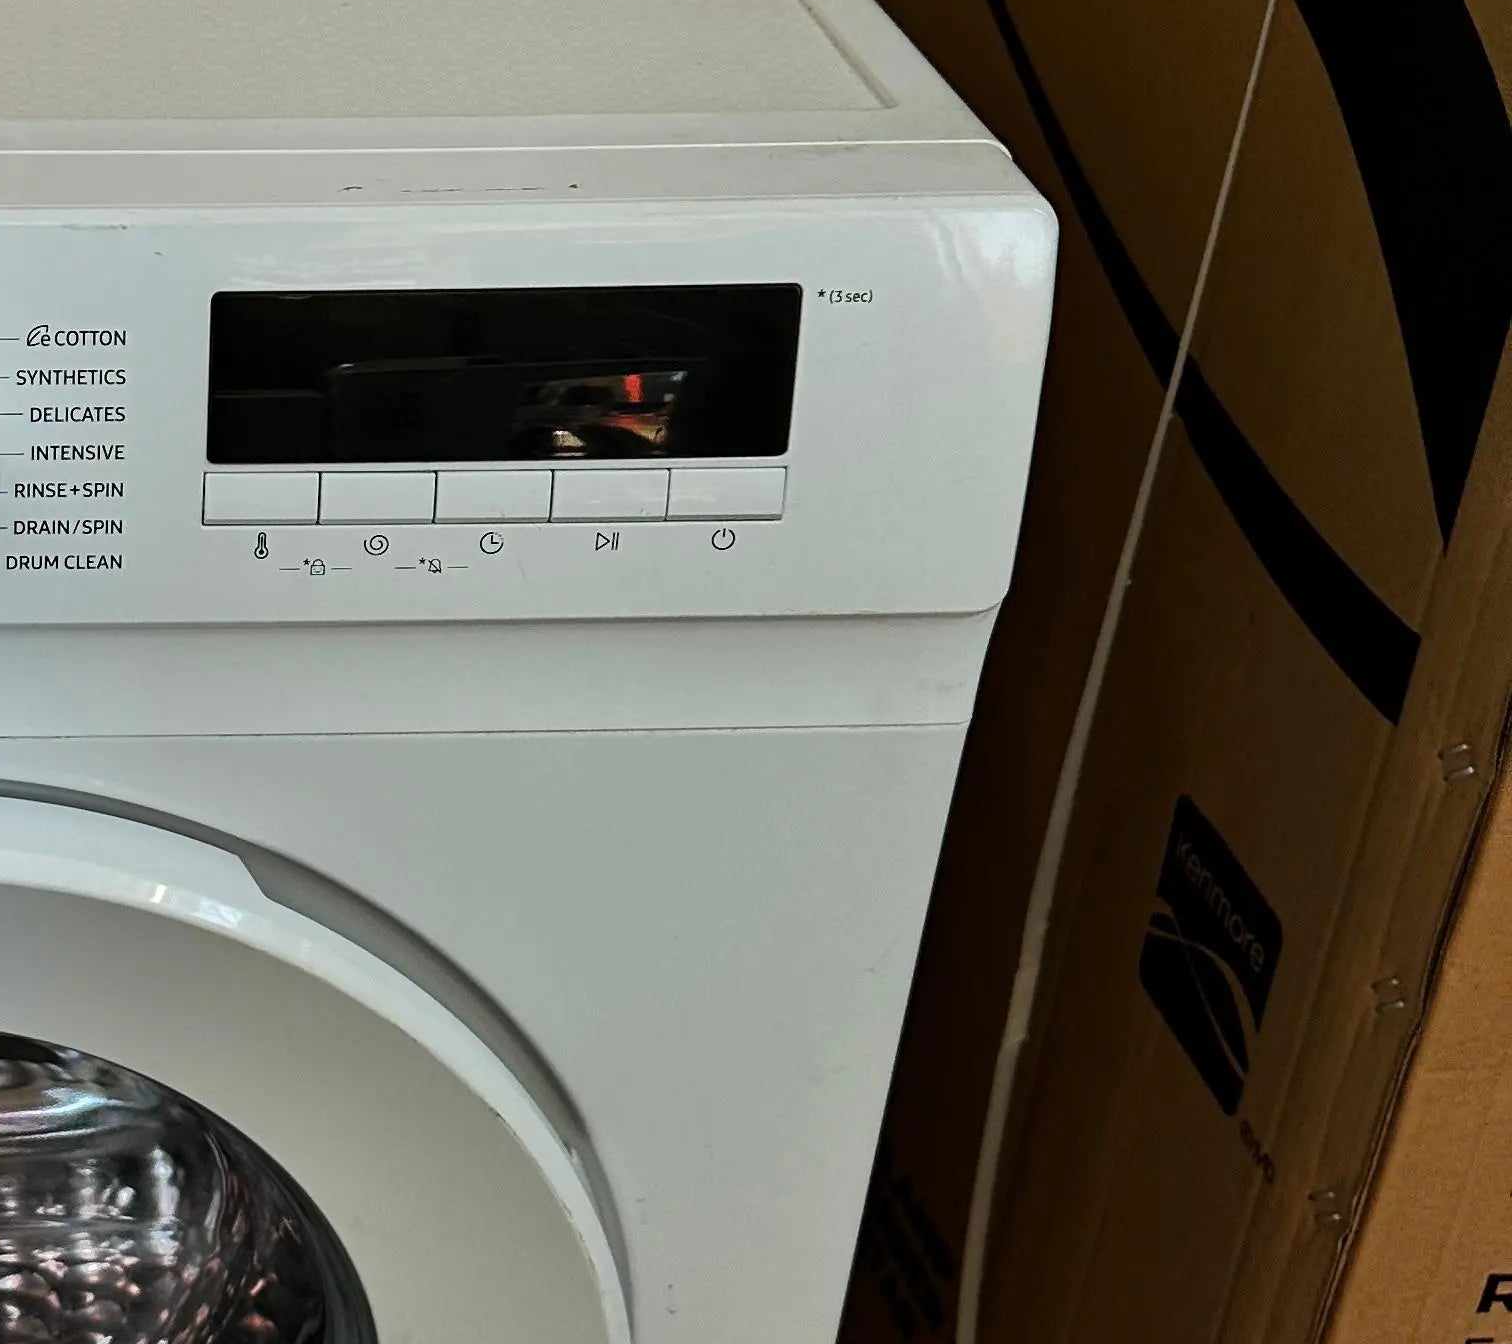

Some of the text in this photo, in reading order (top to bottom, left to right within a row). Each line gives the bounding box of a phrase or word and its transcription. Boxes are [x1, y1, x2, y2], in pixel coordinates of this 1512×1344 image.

[55, 331, 126, 346] COTTON
[17, 370, 126, 385] SYNTHETICS
[31, 407, 125, 422] DELICATES
[32, 445, 124, 460] INTENSIVE
[7, 555, 122, 570] DRUM CLEAN
[1176, 832, 1265, 973] Kenmore
